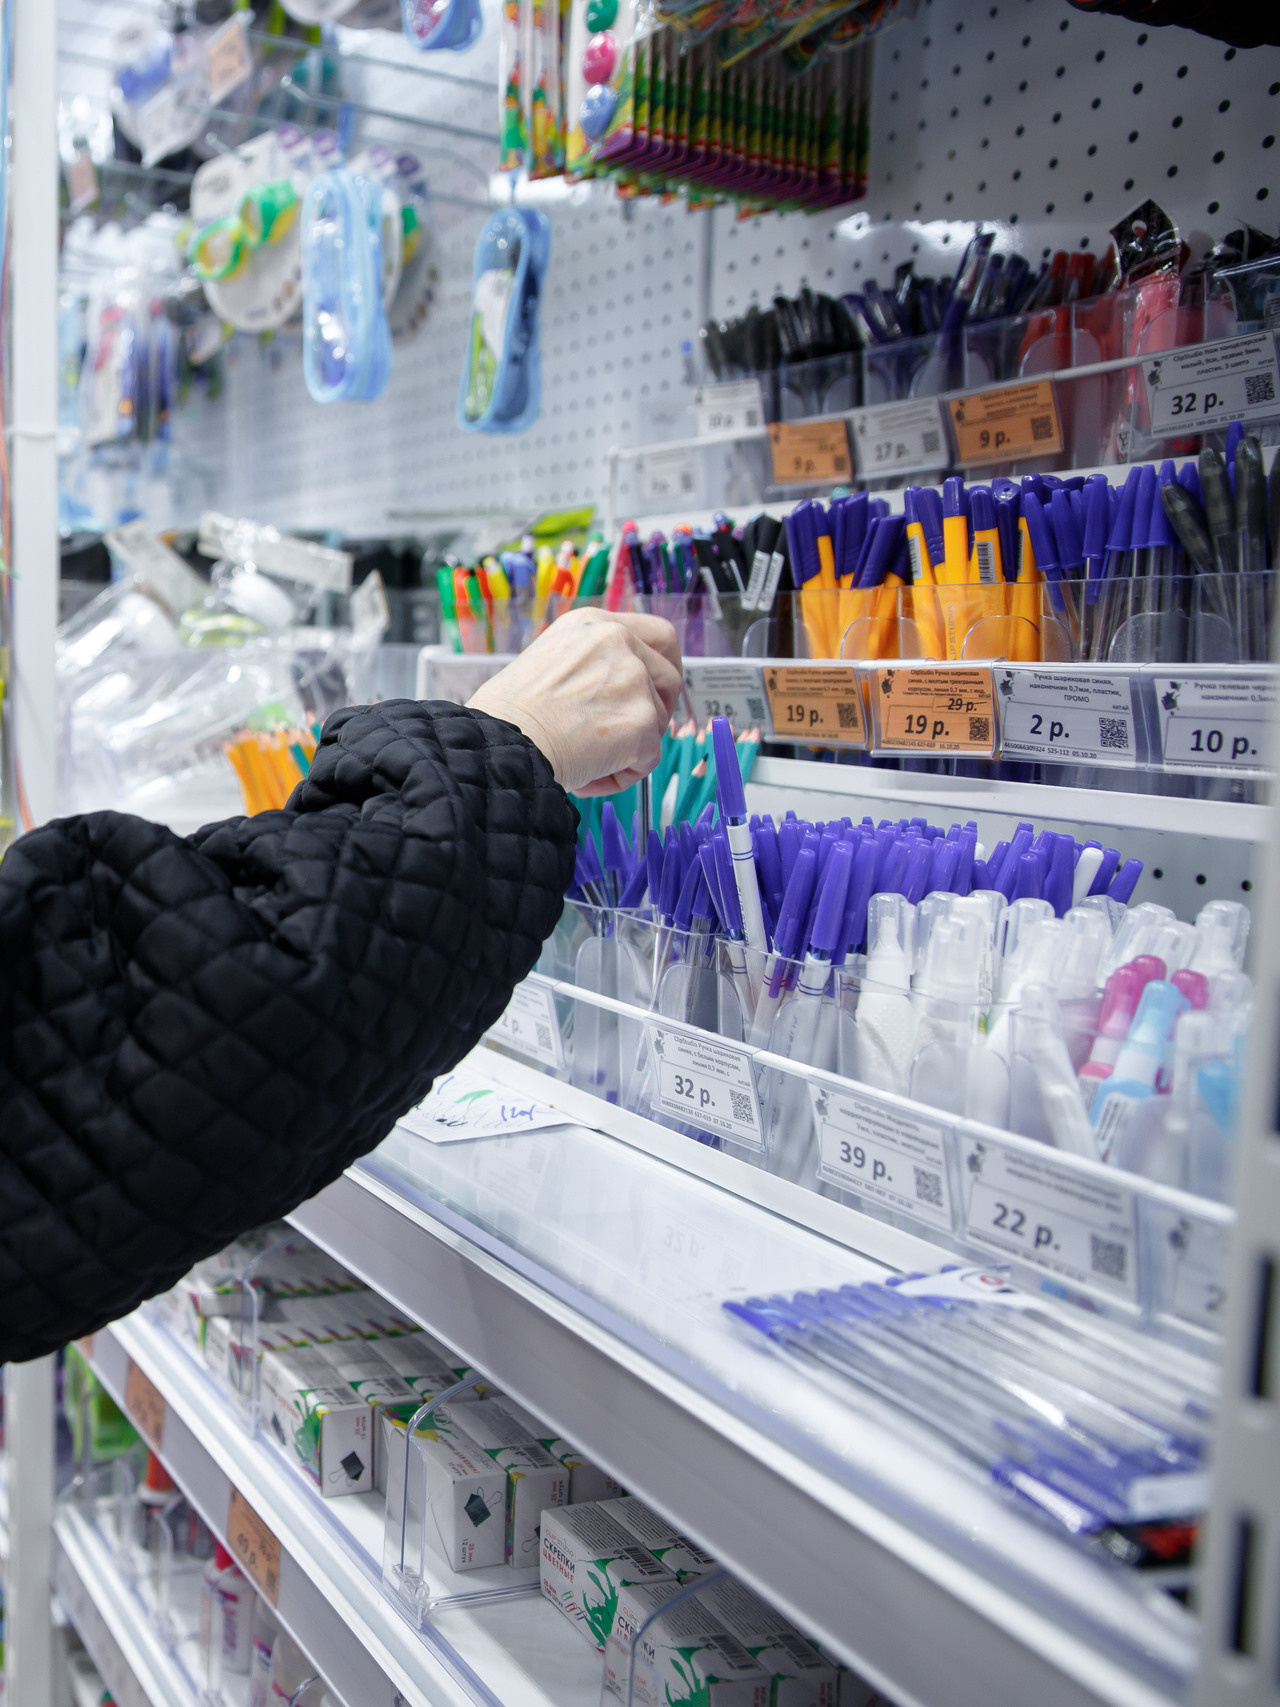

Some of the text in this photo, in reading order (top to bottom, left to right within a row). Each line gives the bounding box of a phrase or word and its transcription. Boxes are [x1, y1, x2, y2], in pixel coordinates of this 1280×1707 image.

[1171, 392, 1224, 415] 32 р.
[980, 429, 1011, 449] 9 р.
[1029, 683, 1068, 691] наконечник
[1092, 688, 1122, 697] пластик,
[1034, 672, 1114, 686] Ручка шариковая синяя,
[1194, 682, 1217, 690] Ручка
[948, 698, 977, 713] 29 р.
[1063, 694, 1090, 703] ПРОМО
[786, 704, 824, 727] 19 р.
[904, 714, 950, 740] 19 р.
[1029, 714, 1070, 742] 2 р.
[1047, 748, 1070, 756] 525-112
[1071, 750, 1097, 759] 05.10.20
[1189, 729, 1258, 760] 10 р.
[674, 1074, 716, 1108] 32 р.
[840, 1140, 893, 1182] 39 р.
[992, 1202, 1061, 1251] 22 р.
[542, 1547, 574, 1584] ЦВЕТНЫЕ
[543, 1537, 575, 1574] СКРЕПКИ
